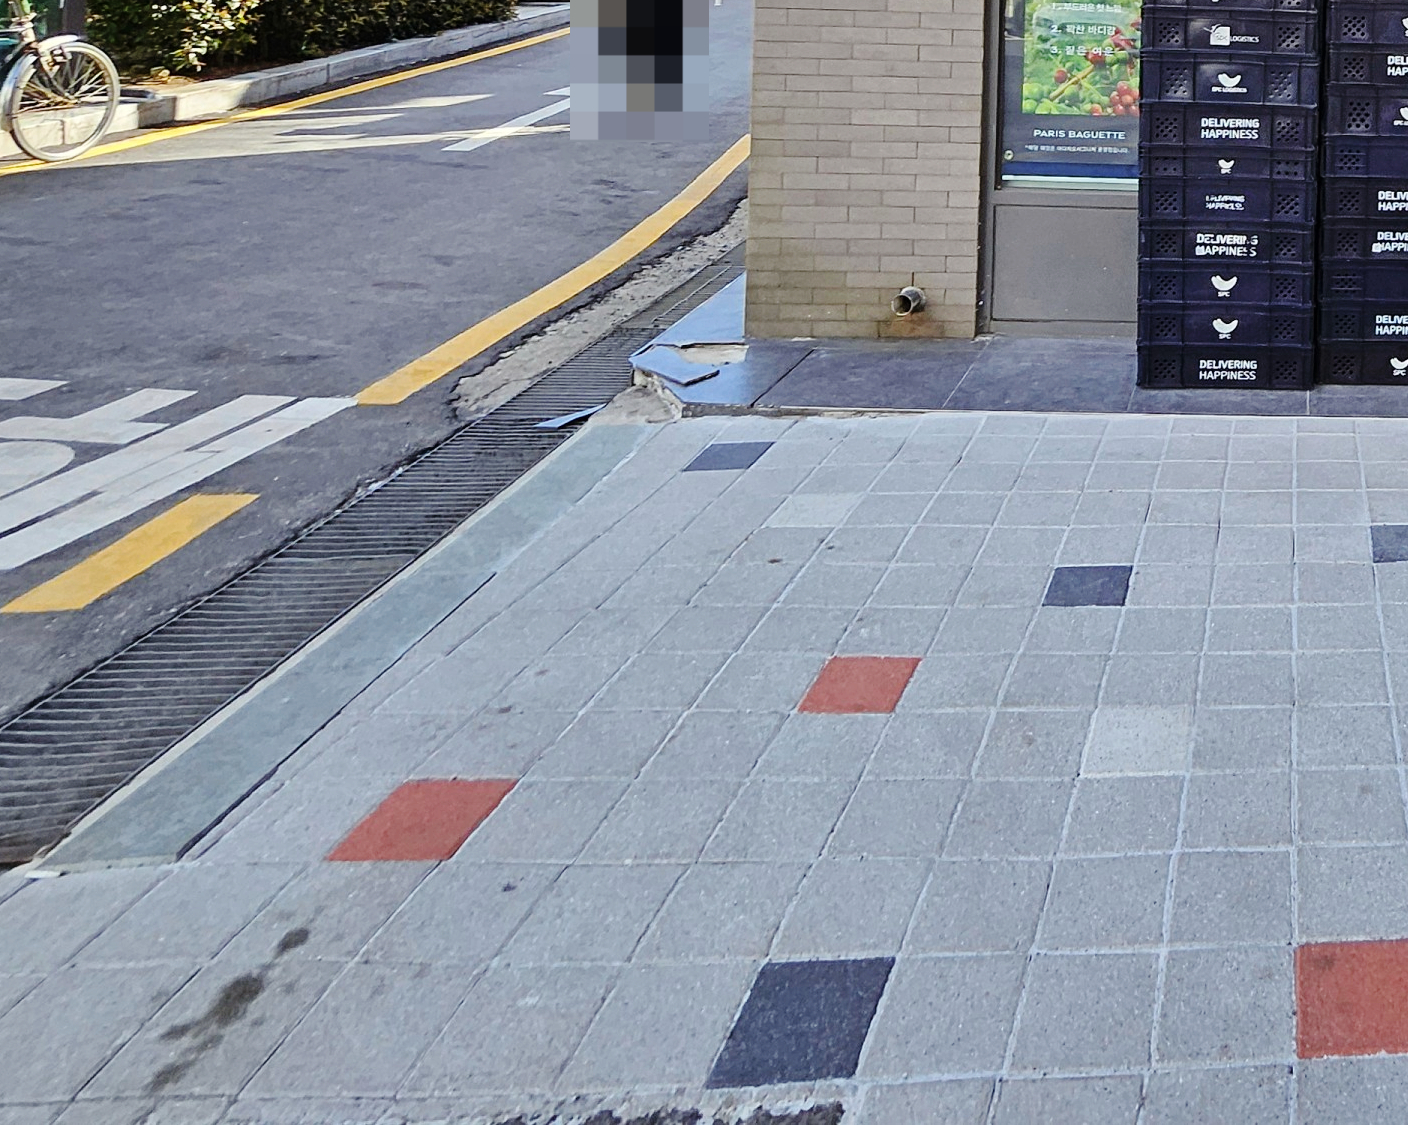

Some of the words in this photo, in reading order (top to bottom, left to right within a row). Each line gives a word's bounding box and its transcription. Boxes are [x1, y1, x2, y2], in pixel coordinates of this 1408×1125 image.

[1050, 24, 1062, 33] 2.
[1230, 35, 1260, 43] LOGISTICS
[1049, 45, 1062, 54] 3.
[1200, 117, 1260, 129] DELIVERING
[1033, 129, 1066, 138] PARIS
[1068, 130, 1126, 140] BAGUETTE
[1200, 128, 1259, 140] HAPPINESS
[1199, 359, 1258, 370] DELIVERING
[1199, 370, 1257, 381] HAPPINESS
